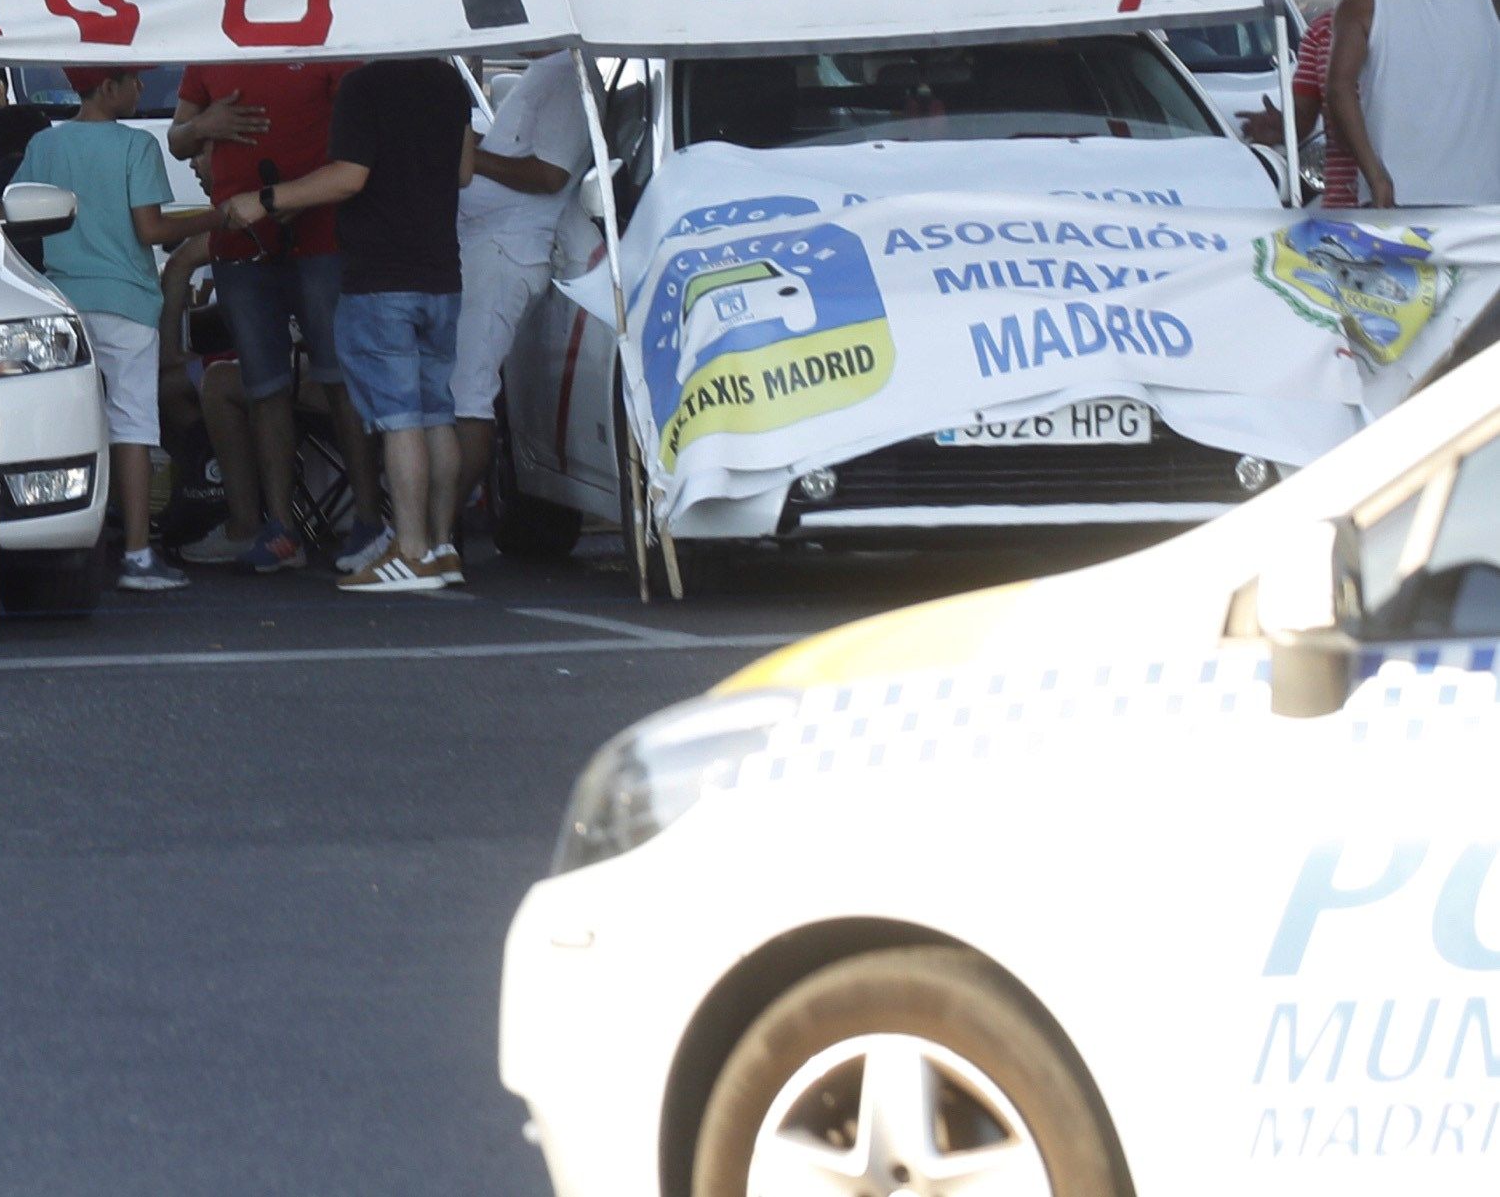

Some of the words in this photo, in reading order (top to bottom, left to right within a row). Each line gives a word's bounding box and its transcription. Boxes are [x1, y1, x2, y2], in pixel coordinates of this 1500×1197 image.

[884, 220, 1229, 256] ASOCIACIÓN
[933, 259, 1172, 295] MILTAXI
[969, 301, 1194, 378] MADRID
[762, 344, 875, 401] MADRID
[1072, 403, 1139, 438] HPG
